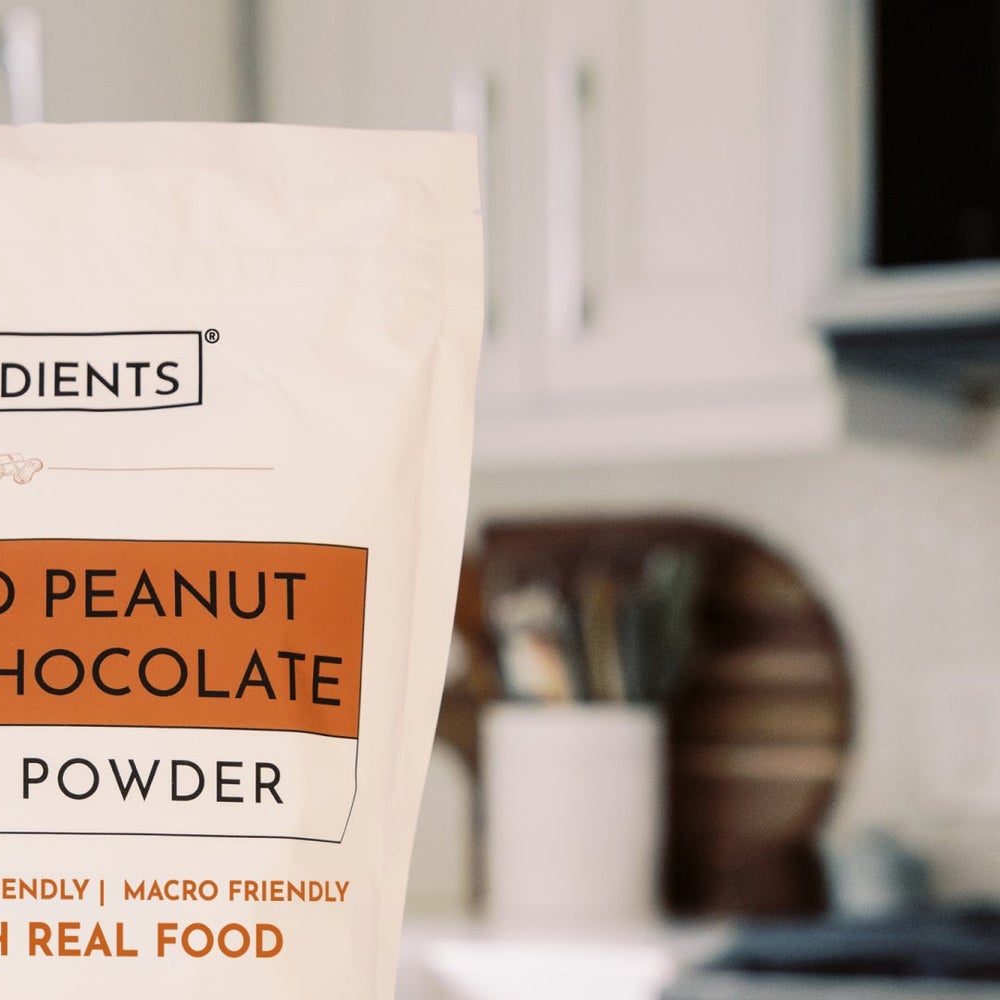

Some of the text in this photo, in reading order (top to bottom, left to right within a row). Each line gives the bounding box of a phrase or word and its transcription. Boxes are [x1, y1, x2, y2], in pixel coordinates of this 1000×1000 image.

[46, 569, 306, 620] PEANUT
[23, 758, 283, 804] POWDER
[125, 880, 218, 901] MACRO
[230, 880, 349, 902] FRIENDLY
[29, 921, 138, 957] REAL
[158, 923, 283, 958] FOOD
